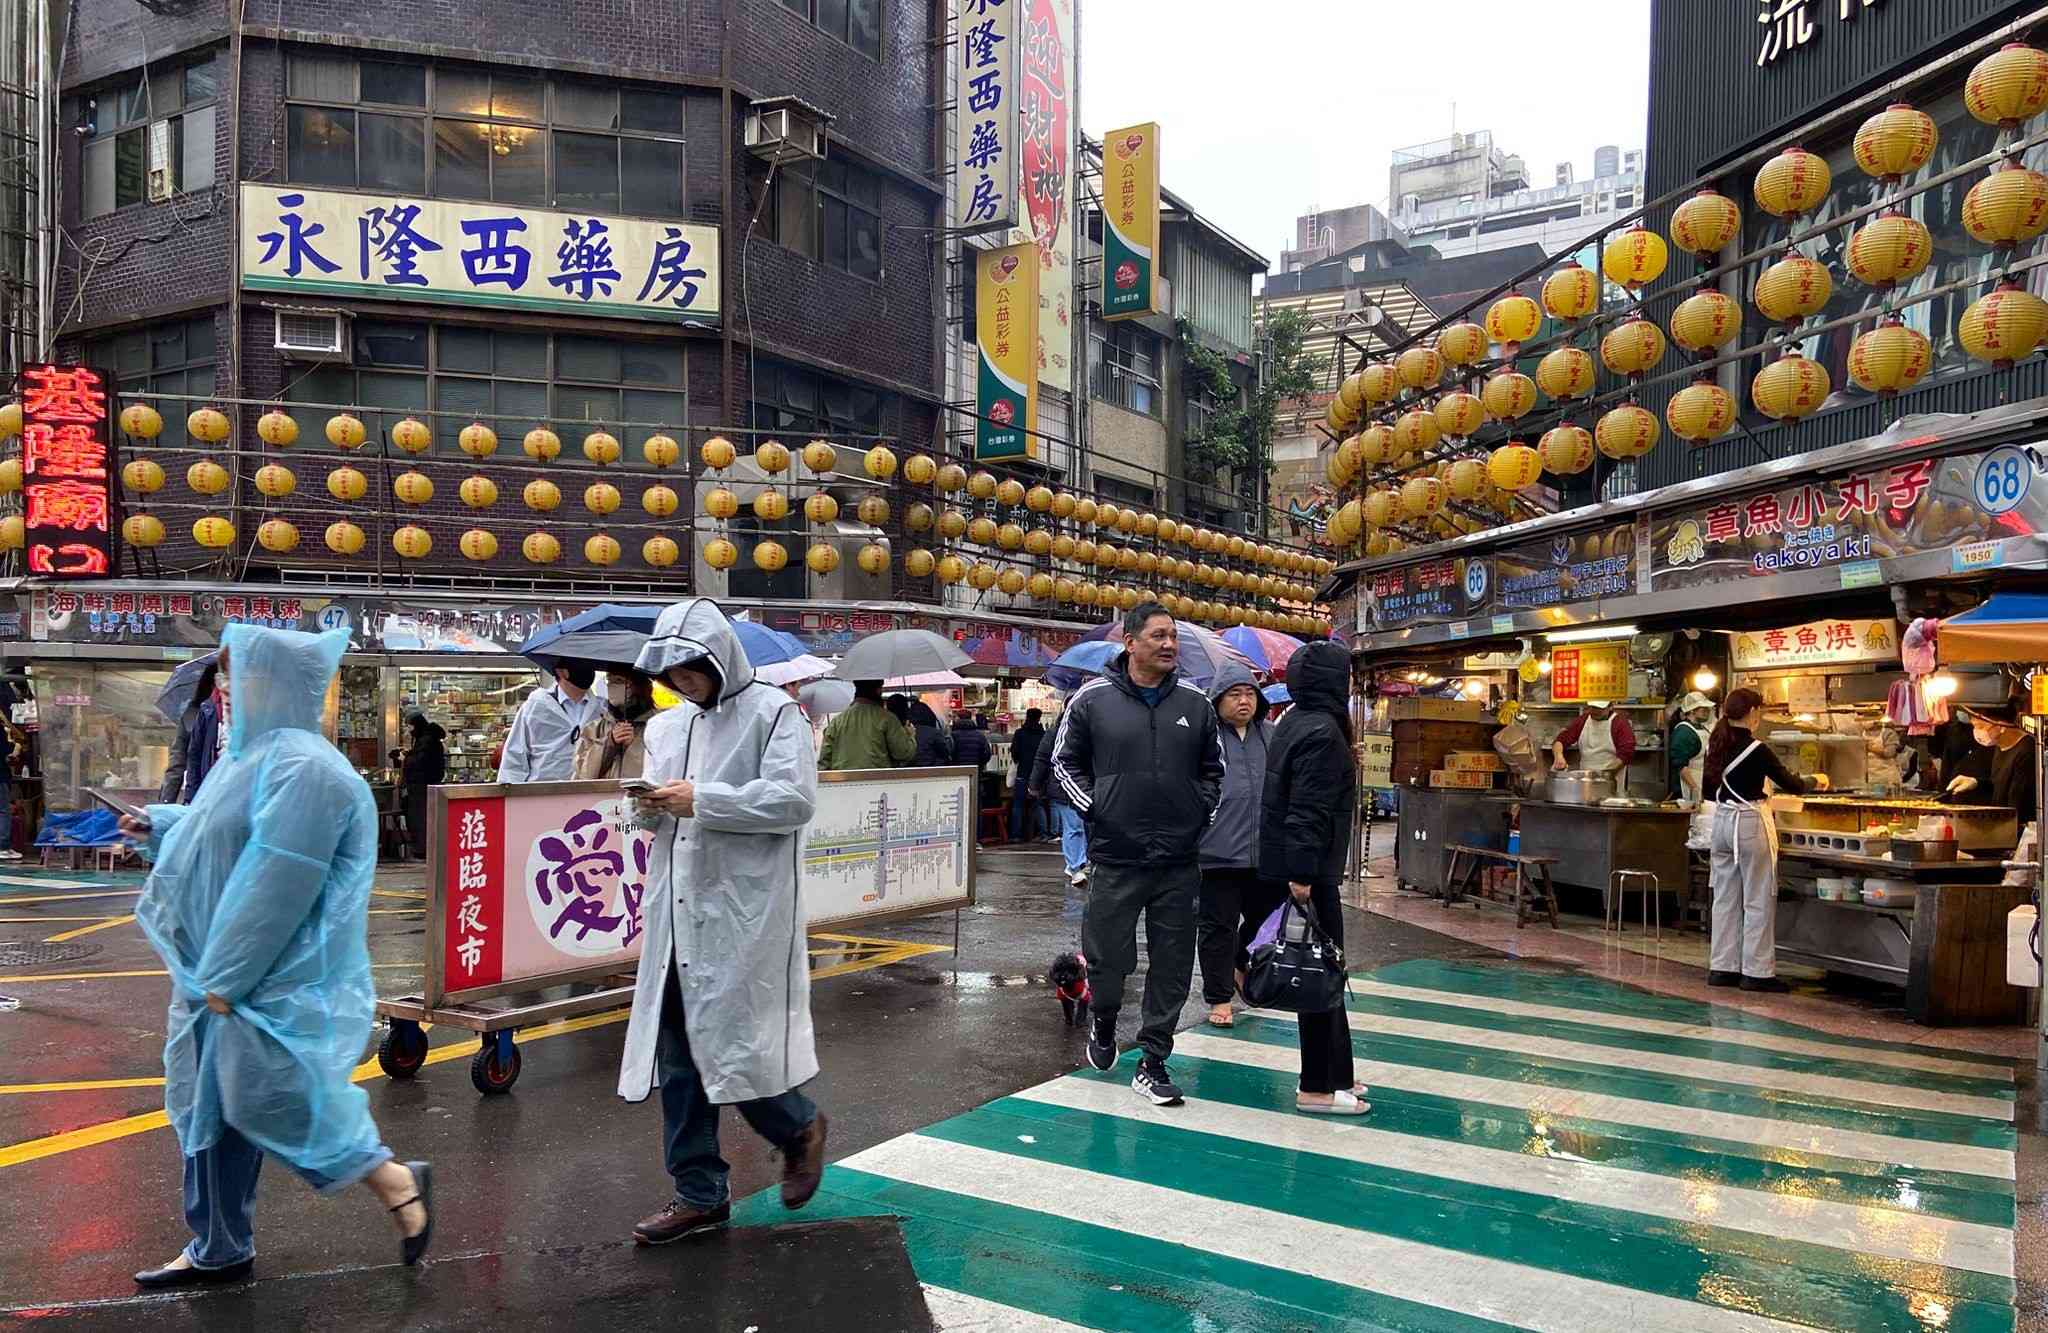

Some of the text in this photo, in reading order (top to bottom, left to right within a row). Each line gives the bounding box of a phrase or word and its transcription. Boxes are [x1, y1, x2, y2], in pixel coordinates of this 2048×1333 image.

[963, 0, 1006, 223] 隆西藥房
[1121, 162, 1136, 226] 公益彩券
[256, 192, 708, 309] 永隆西藥房
[994, 287, 1012, 359] 公益彩券
[23, 365, 109, 573] 基隆廟口
[1983, 456, 2020, 503] 68
[1704, 459, 1933, 543] 章魚小丸子
[1753, 534, 1872, 570] takoyaki
[1783, 525, 1836, 547] たこ焼き
[1964, 549, 1992, 564] 1950
[1468, 565, 1484, 593] 66
[323, 609, 345, 628] 47
[776, 611, 893, 632] 一口吃香腸
[1763, 622, 1857, 655] 章魚燒
[456, 809, 489, 977] 蒞臨夜市
